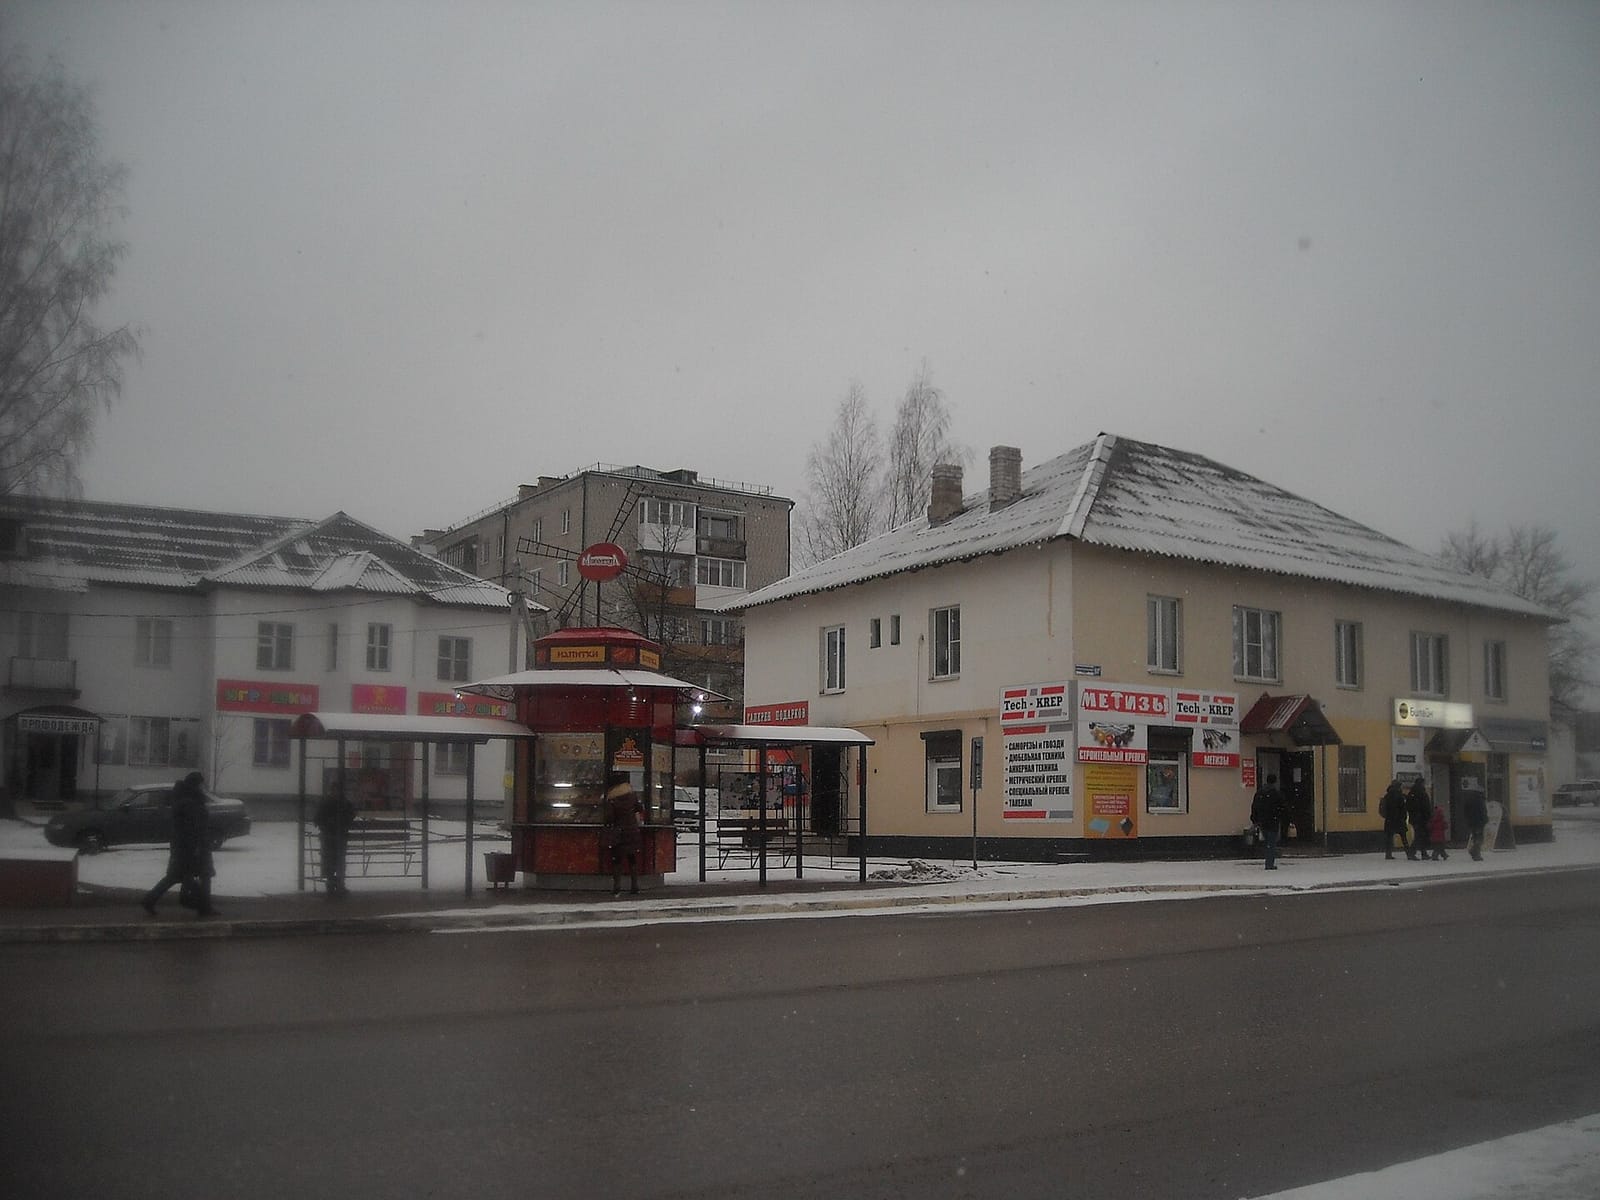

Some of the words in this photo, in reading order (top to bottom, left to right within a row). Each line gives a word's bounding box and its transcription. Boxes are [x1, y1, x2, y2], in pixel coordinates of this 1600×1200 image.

[1004, 698, 1027, 710] Tech
[1036, 696, 1063, 708] KREP
[1081, 691, 1169, 713] МЕТИЗЫ
[1176, 702, 1200, 714] Tech
[1208, 704, 1234, 716] KREP
[775, 708, 806, 722] ПОДАРКОВ
[1008, 741, 1038, 750] САМОРЕЗЫ
[1043, 739, 1065, 749] ГВОЗДИ
[1042, 751, 1066, 761] ТЕХНИКА
[1079, 749, 1124, 761] СТРОИТЕЛЬНЫЙ
[1124, 751, 1146, 763] КРЕПЕЖ
[1203, 755, 1230, 765] МЕТИЗЫ
[1008, 764, 1035, 773] АНКЕРНАЯ
[1035, 763, 1059, 772] ТЕХНИКА
[1008, 774, 1046, 785] МЕТРИЧЕСКИЙ
[1046, 775, 1067, 784] КРЕПЕЖ
[1008, 785, 1049, 796] СПЕЦИАЛЬНЫЙ
[1049, 786, 1070, 795] КРЕПЕЖ
